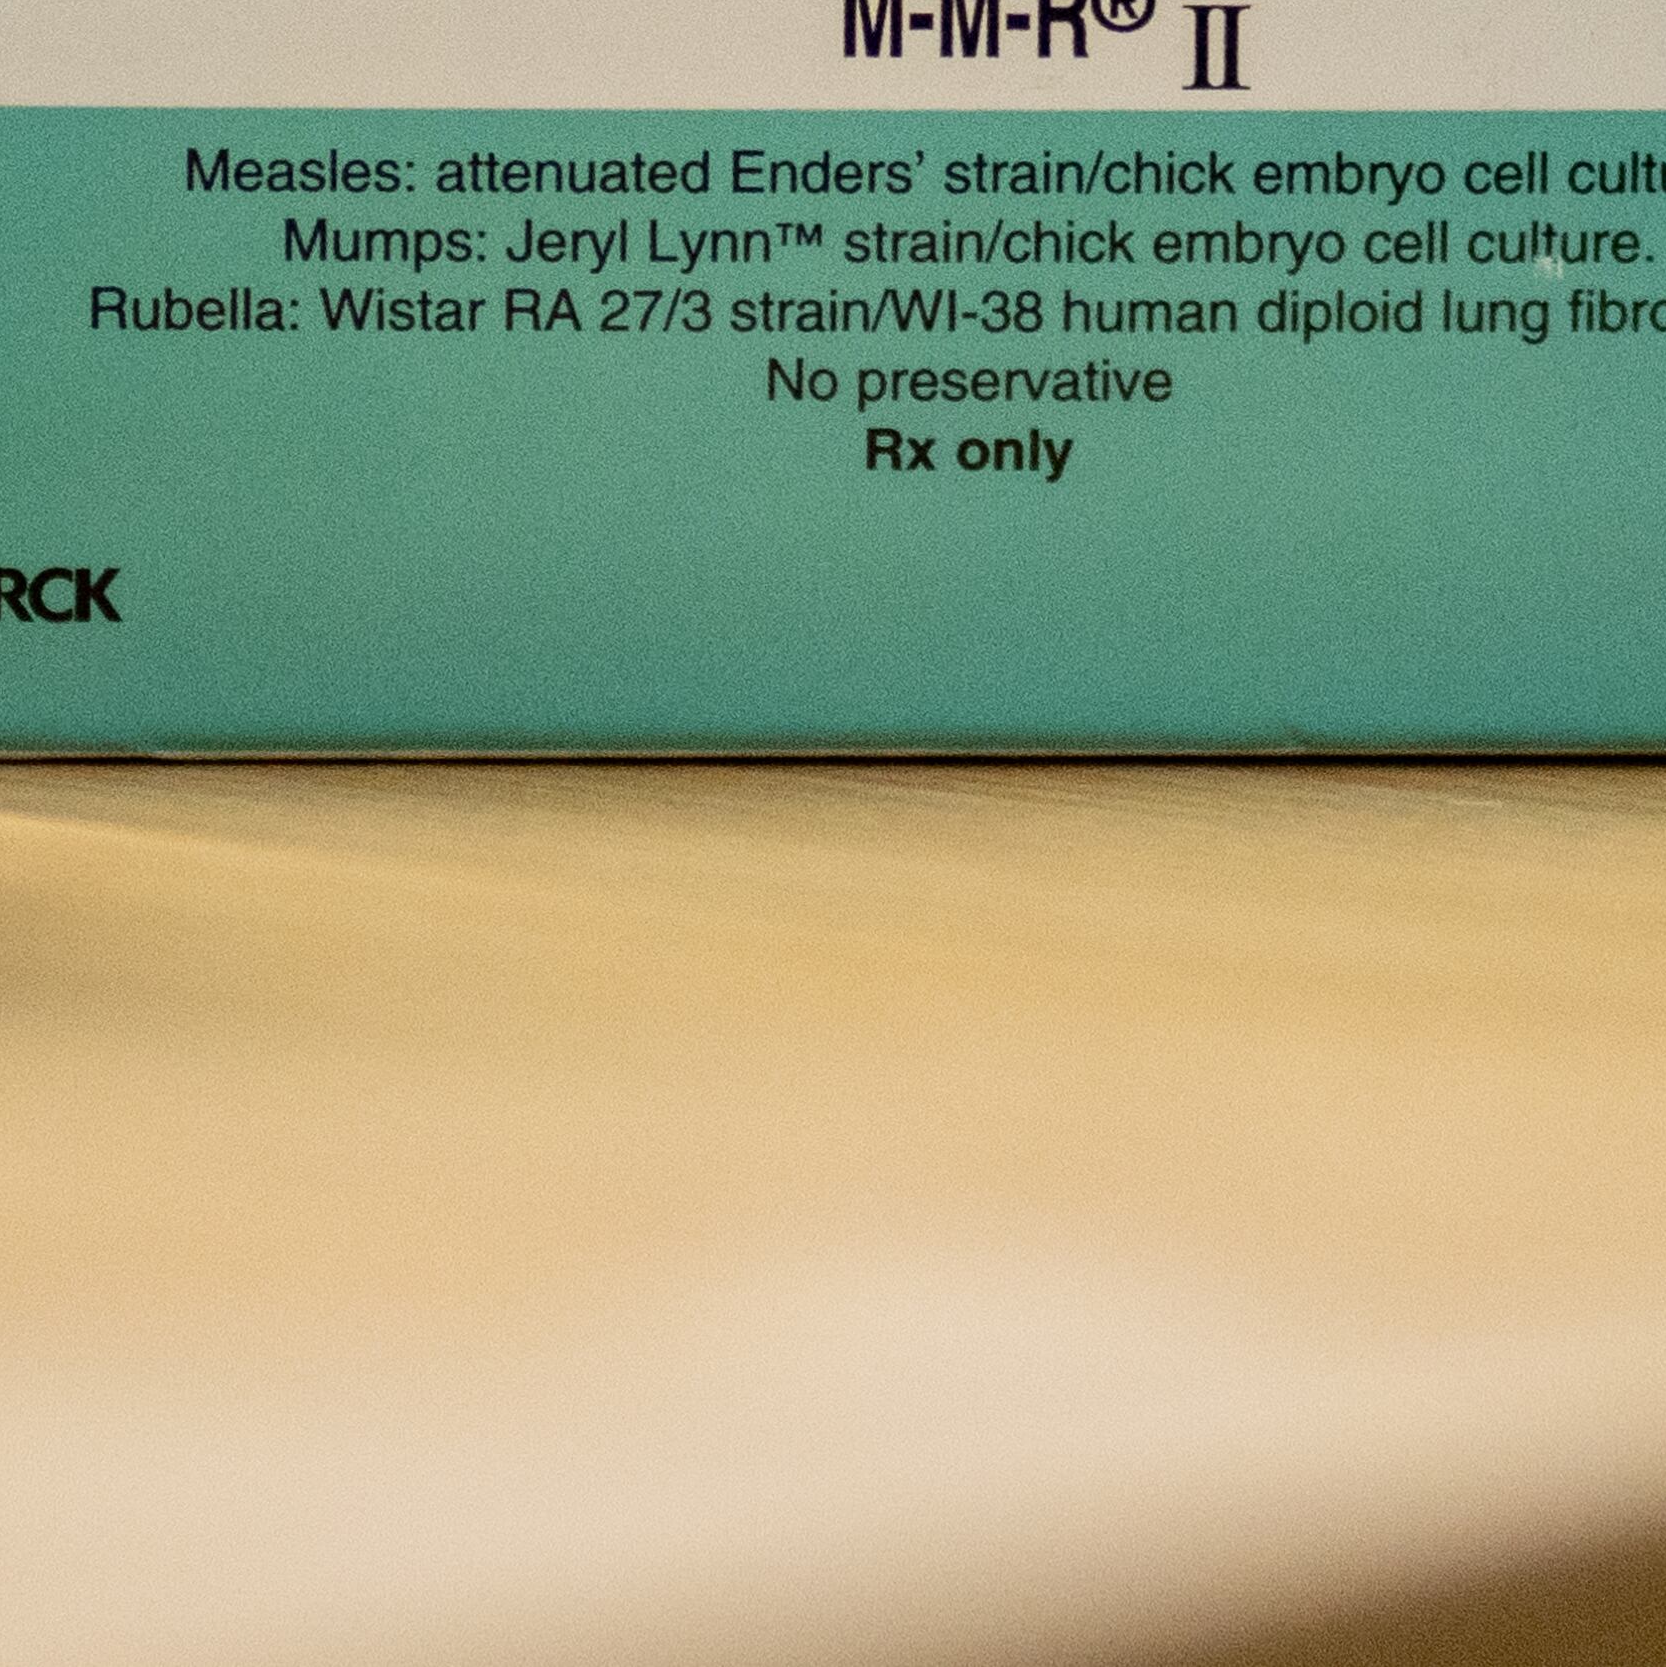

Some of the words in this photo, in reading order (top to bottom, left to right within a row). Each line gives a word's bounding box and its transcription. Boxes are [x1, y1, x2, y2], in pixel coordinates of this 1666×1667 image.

[1183, 3, 1251, 91] II
[185, 146, 416, 196] Measles:
[435, 149, 711, 196] attenuated
[943, 149, 1236, 196] strain/chick
[1252, 150, 1447, 208] embryo
[1463, 150, 1550, 196] cell
[283, 216, 487, 275] Mumps:
[505, 217, 629, 275] Jeryl
[843, 218, 1135, 265] strain/chick
[1152, 219, 1347, 278] embryo
[1363, 219, 1449, 265] cell
[1466, 219, 1655, 265] culture.
[89, 284, 300, 333] Rubella:
[318, 286, 487, 333] Wistar
[504, 286, 583, 332] RA
[599, 287, 713, 334] 27/3
[729, 287, 1044, 334] strain/WI-38
[1062, 288, 1239, 334] human
[1256, 288, 1424, 345] diploid
[1442, 288, 1551, 346] lung
[767, 356, 840, 403] No
[856, 358, 1174, 413] preservative
[865, 426, 937, 472] Rx
[955, 426, 1075, 484] only
